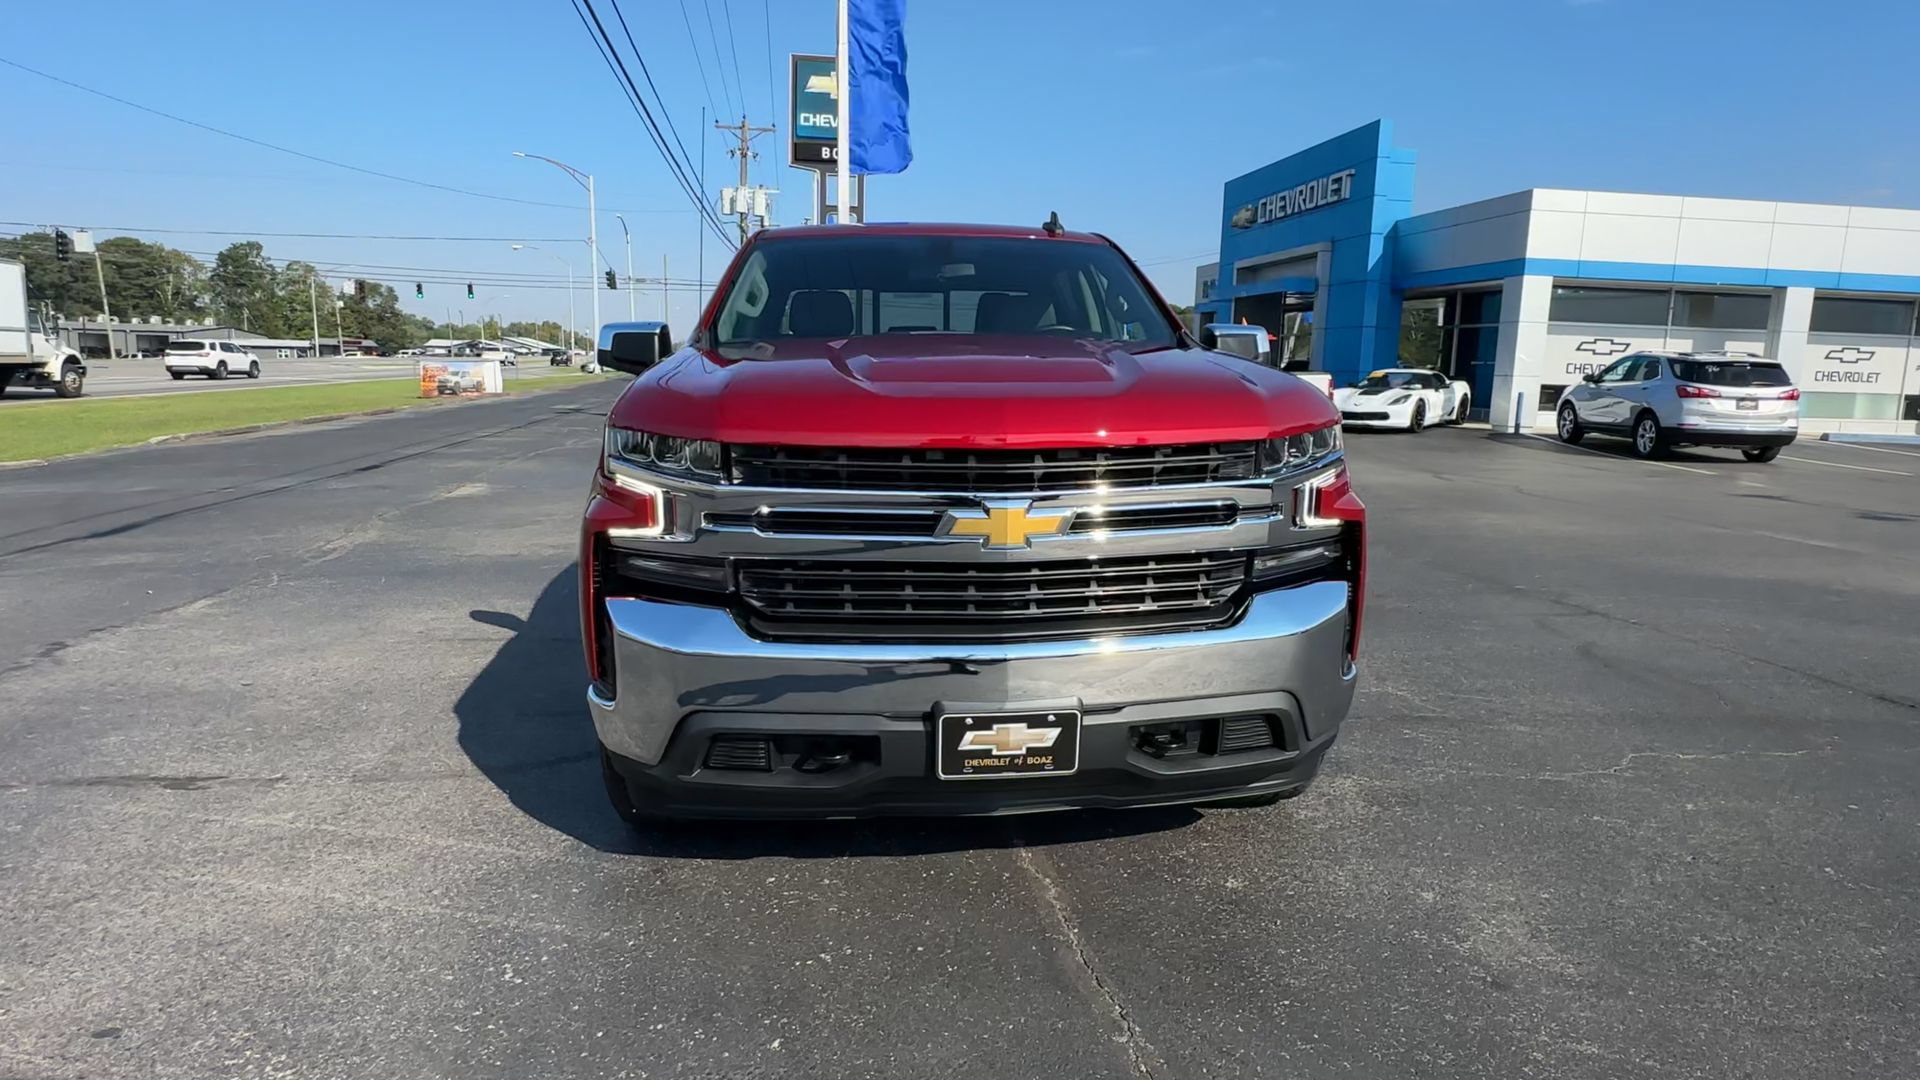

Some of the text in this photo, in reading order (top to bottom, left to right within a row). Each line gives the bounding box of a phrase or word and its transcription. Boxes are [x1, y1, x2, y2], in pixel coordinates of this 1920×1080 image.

[1257, 168, 1356, 223] CHEVROLET
[1814, 370, 1881, 383] CHEVROLET
[964, 757, 1011, 767] CHEVROLET
[1027, 756, 1053, 765] BOAZ
